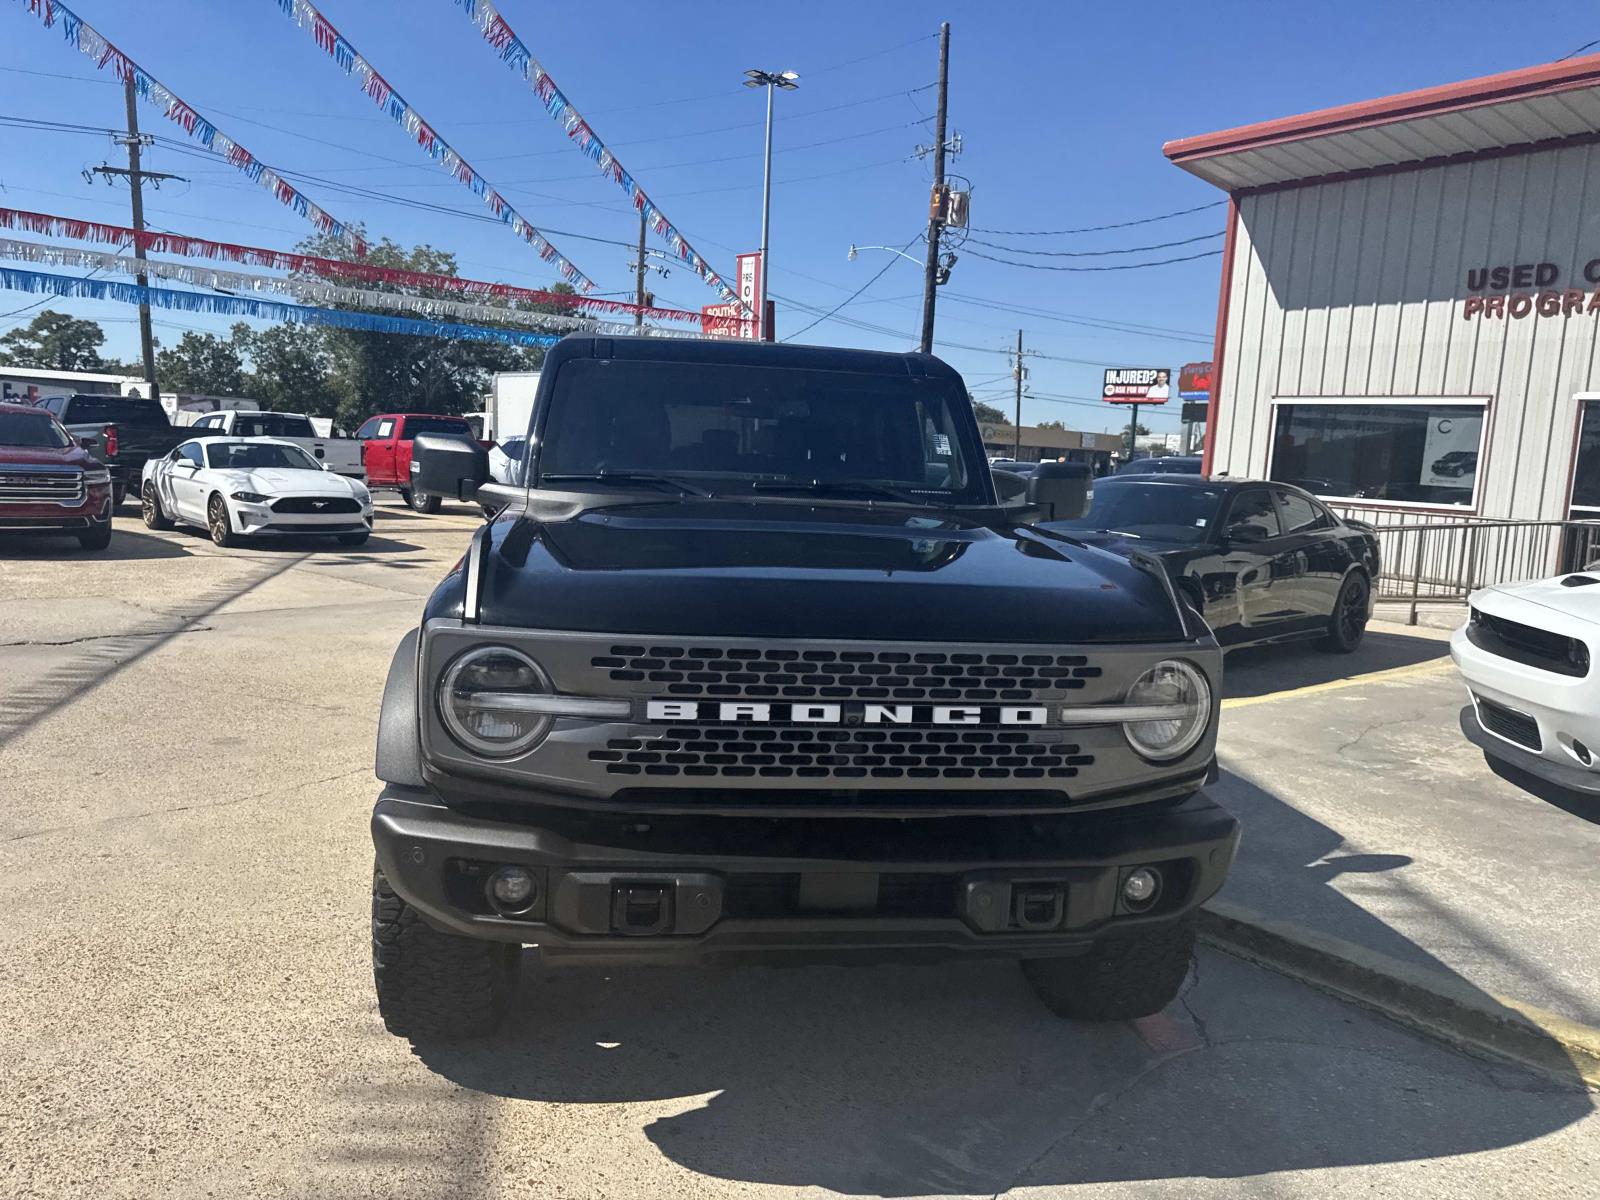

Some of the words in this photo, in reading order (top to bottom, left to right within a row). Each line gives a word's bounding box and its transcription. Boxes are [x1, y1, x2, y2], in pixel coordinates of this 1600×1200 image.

[1467, 262, 1559, 291] USED
[1105, 370, 1158, 384] INJURED?
[646, 701, 1048, 724] BRONCO
